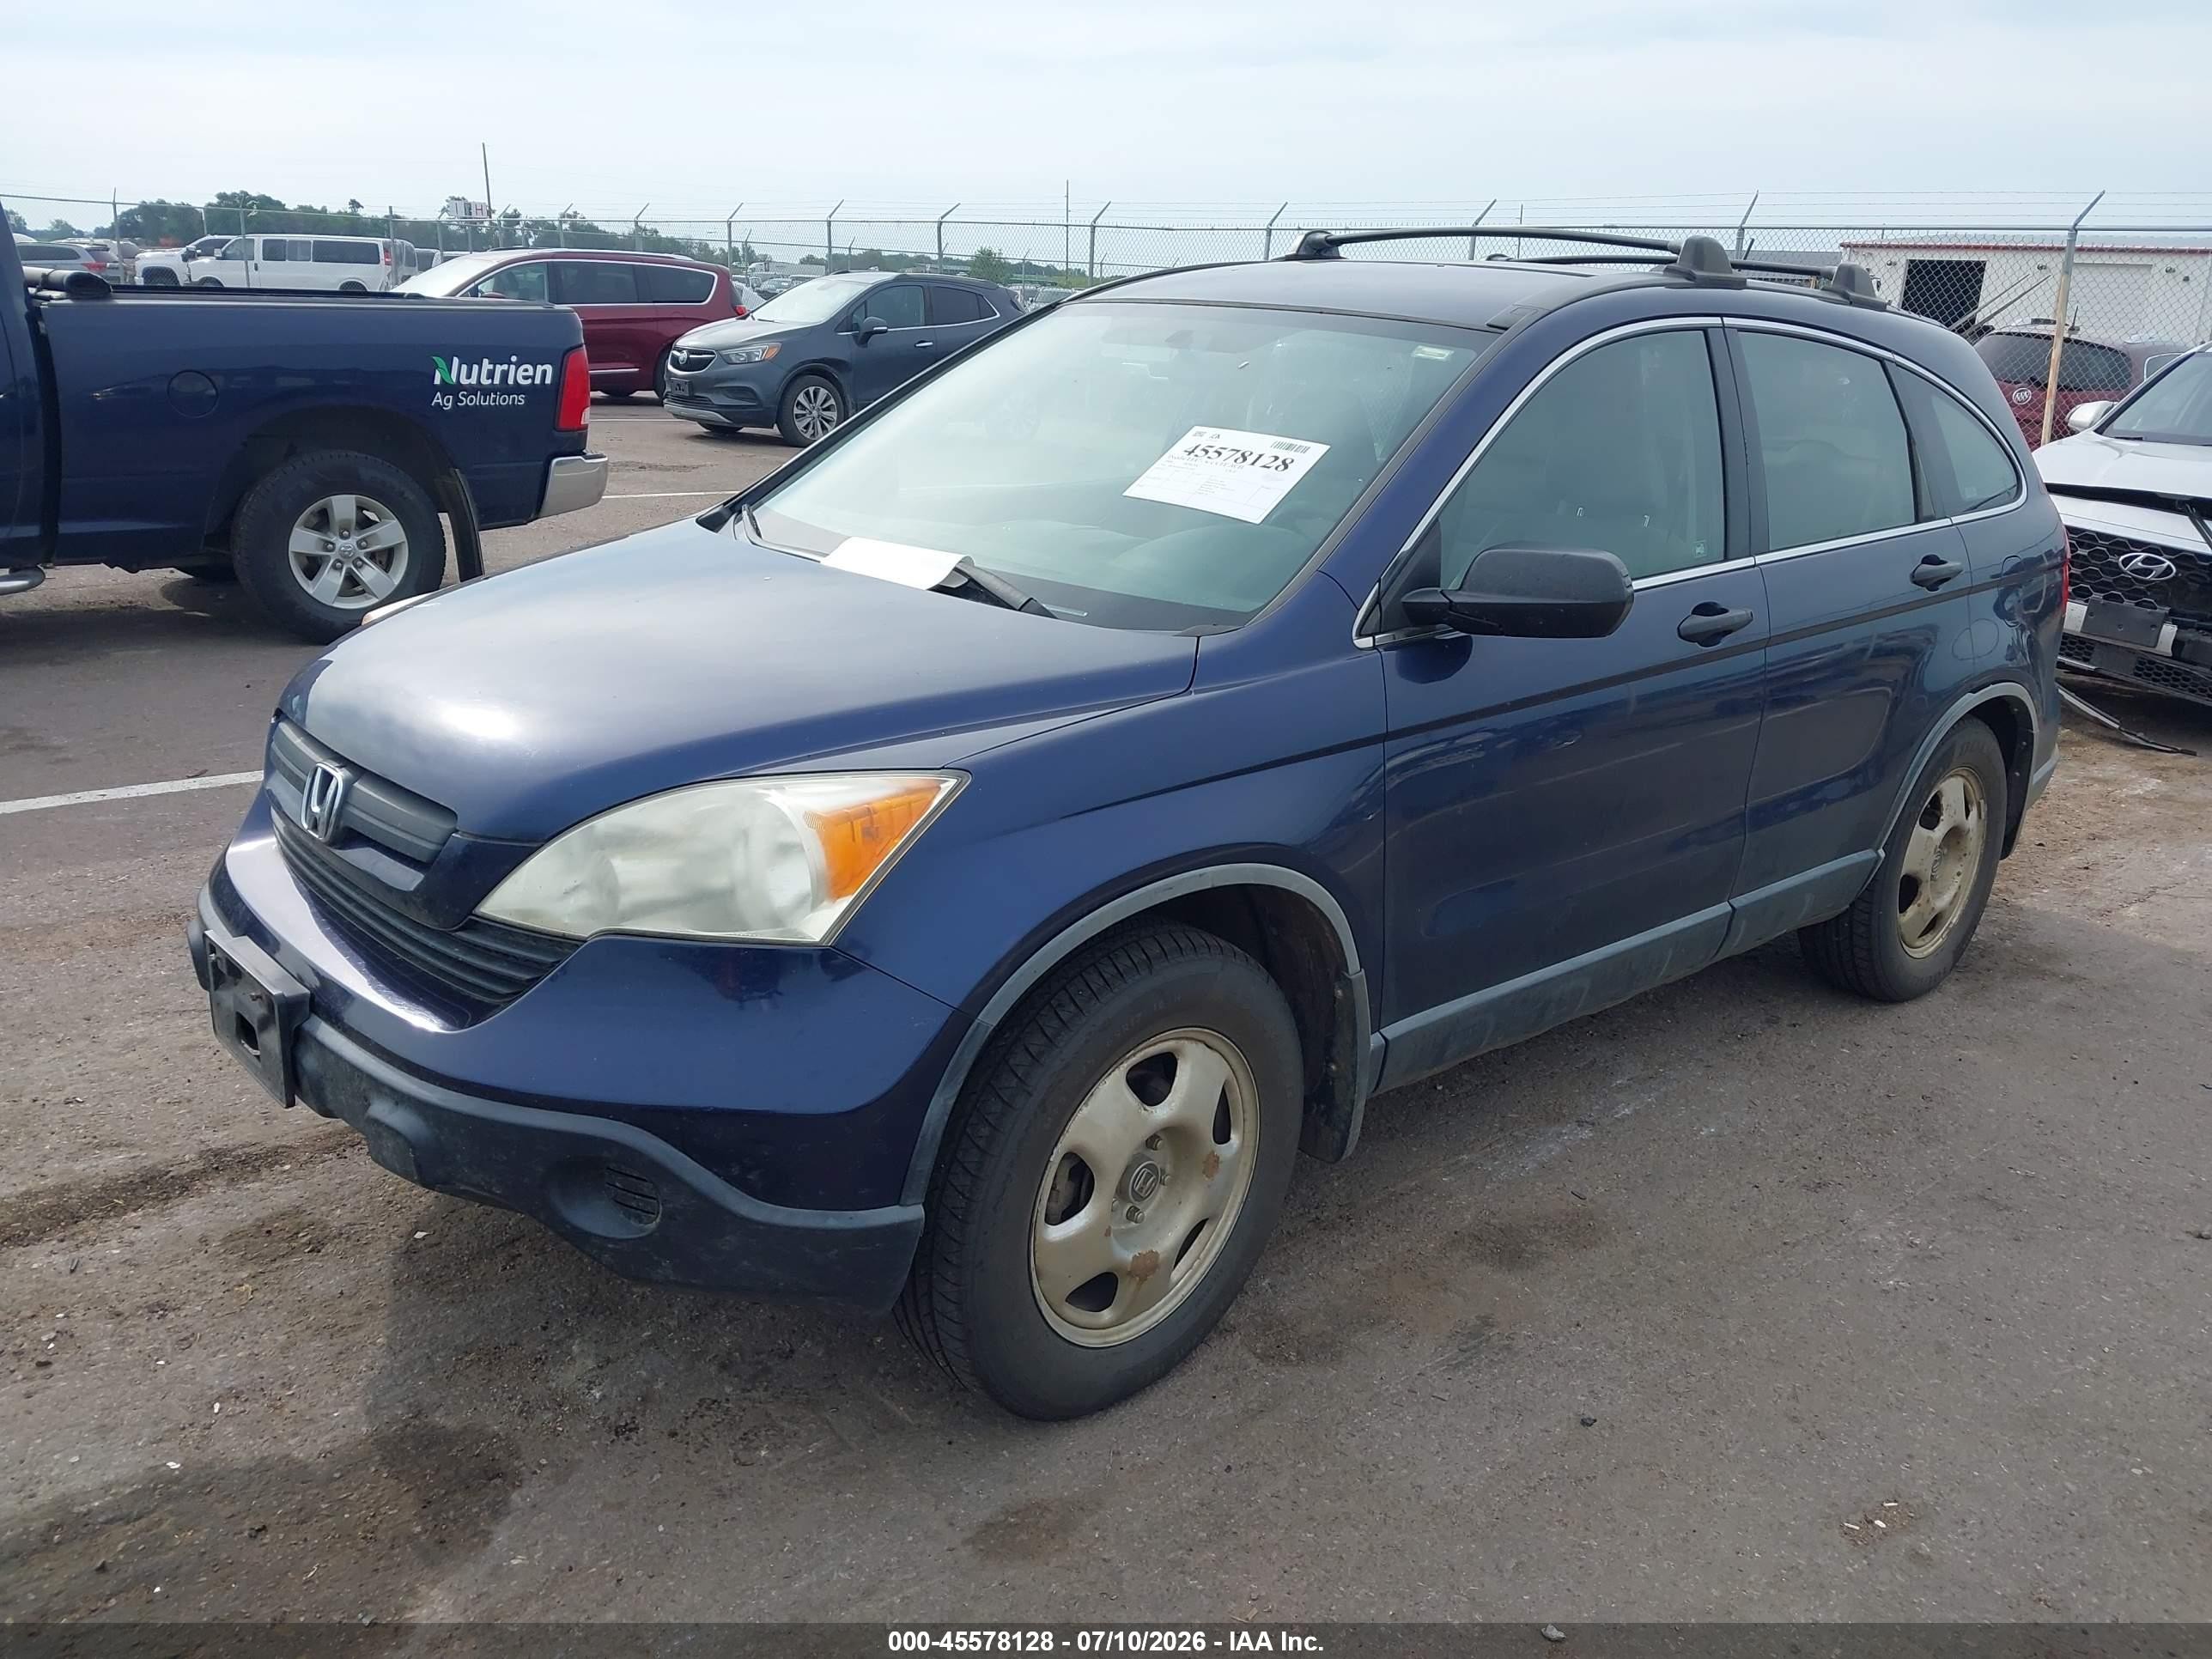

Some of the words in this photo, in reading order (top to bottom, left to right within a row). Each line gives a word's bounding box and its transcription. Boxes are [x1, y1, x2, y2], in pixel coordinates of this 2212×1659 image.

[432, 355, 553, 385] Nutrien
[431, 391, 453, 410] Ag
[457, 391, 526, 406] Solutions
[1184, 443, 1295, 472] 45578128
